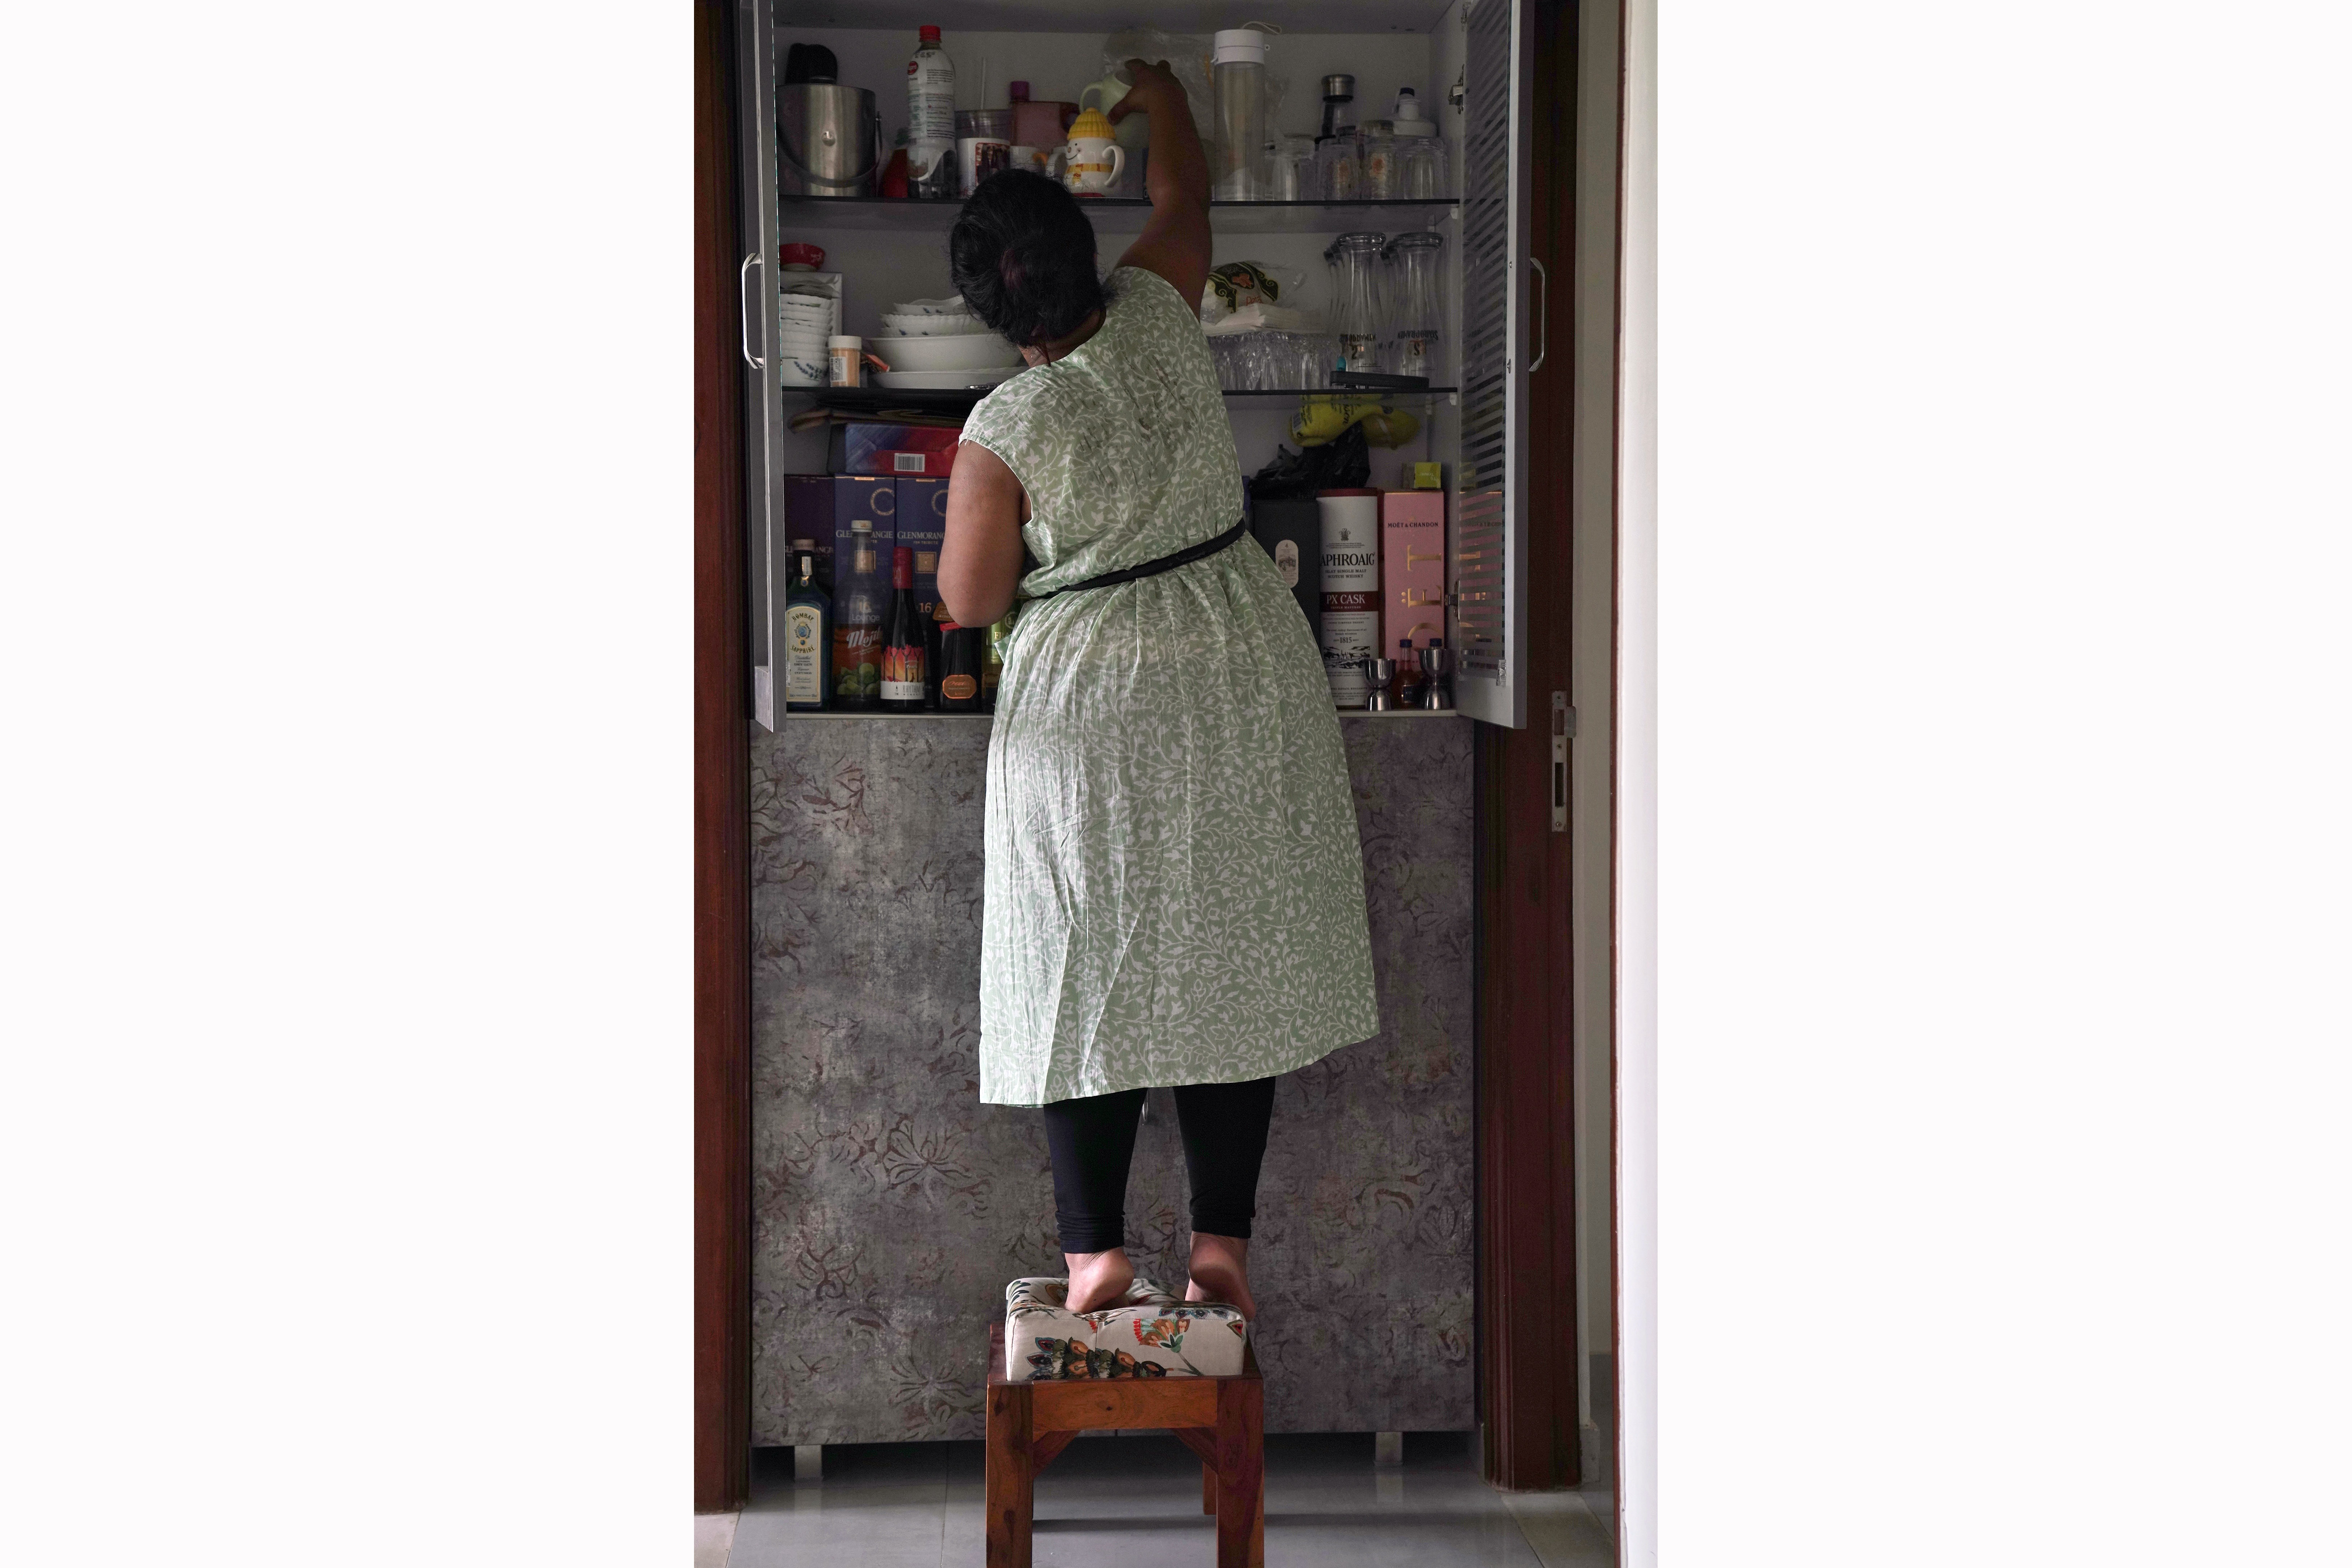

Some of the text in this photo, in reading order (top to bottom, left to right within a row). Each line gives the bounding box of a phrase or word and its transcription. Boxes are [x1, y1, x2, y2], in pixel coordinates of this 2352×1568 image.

[1320, 553, 1375, 566] APHROAIG
[1327, 594, 1365, 604] PX CASK
[919, 603, 932, 613] 16
[791, 613, 814, 621] BOMBAY
